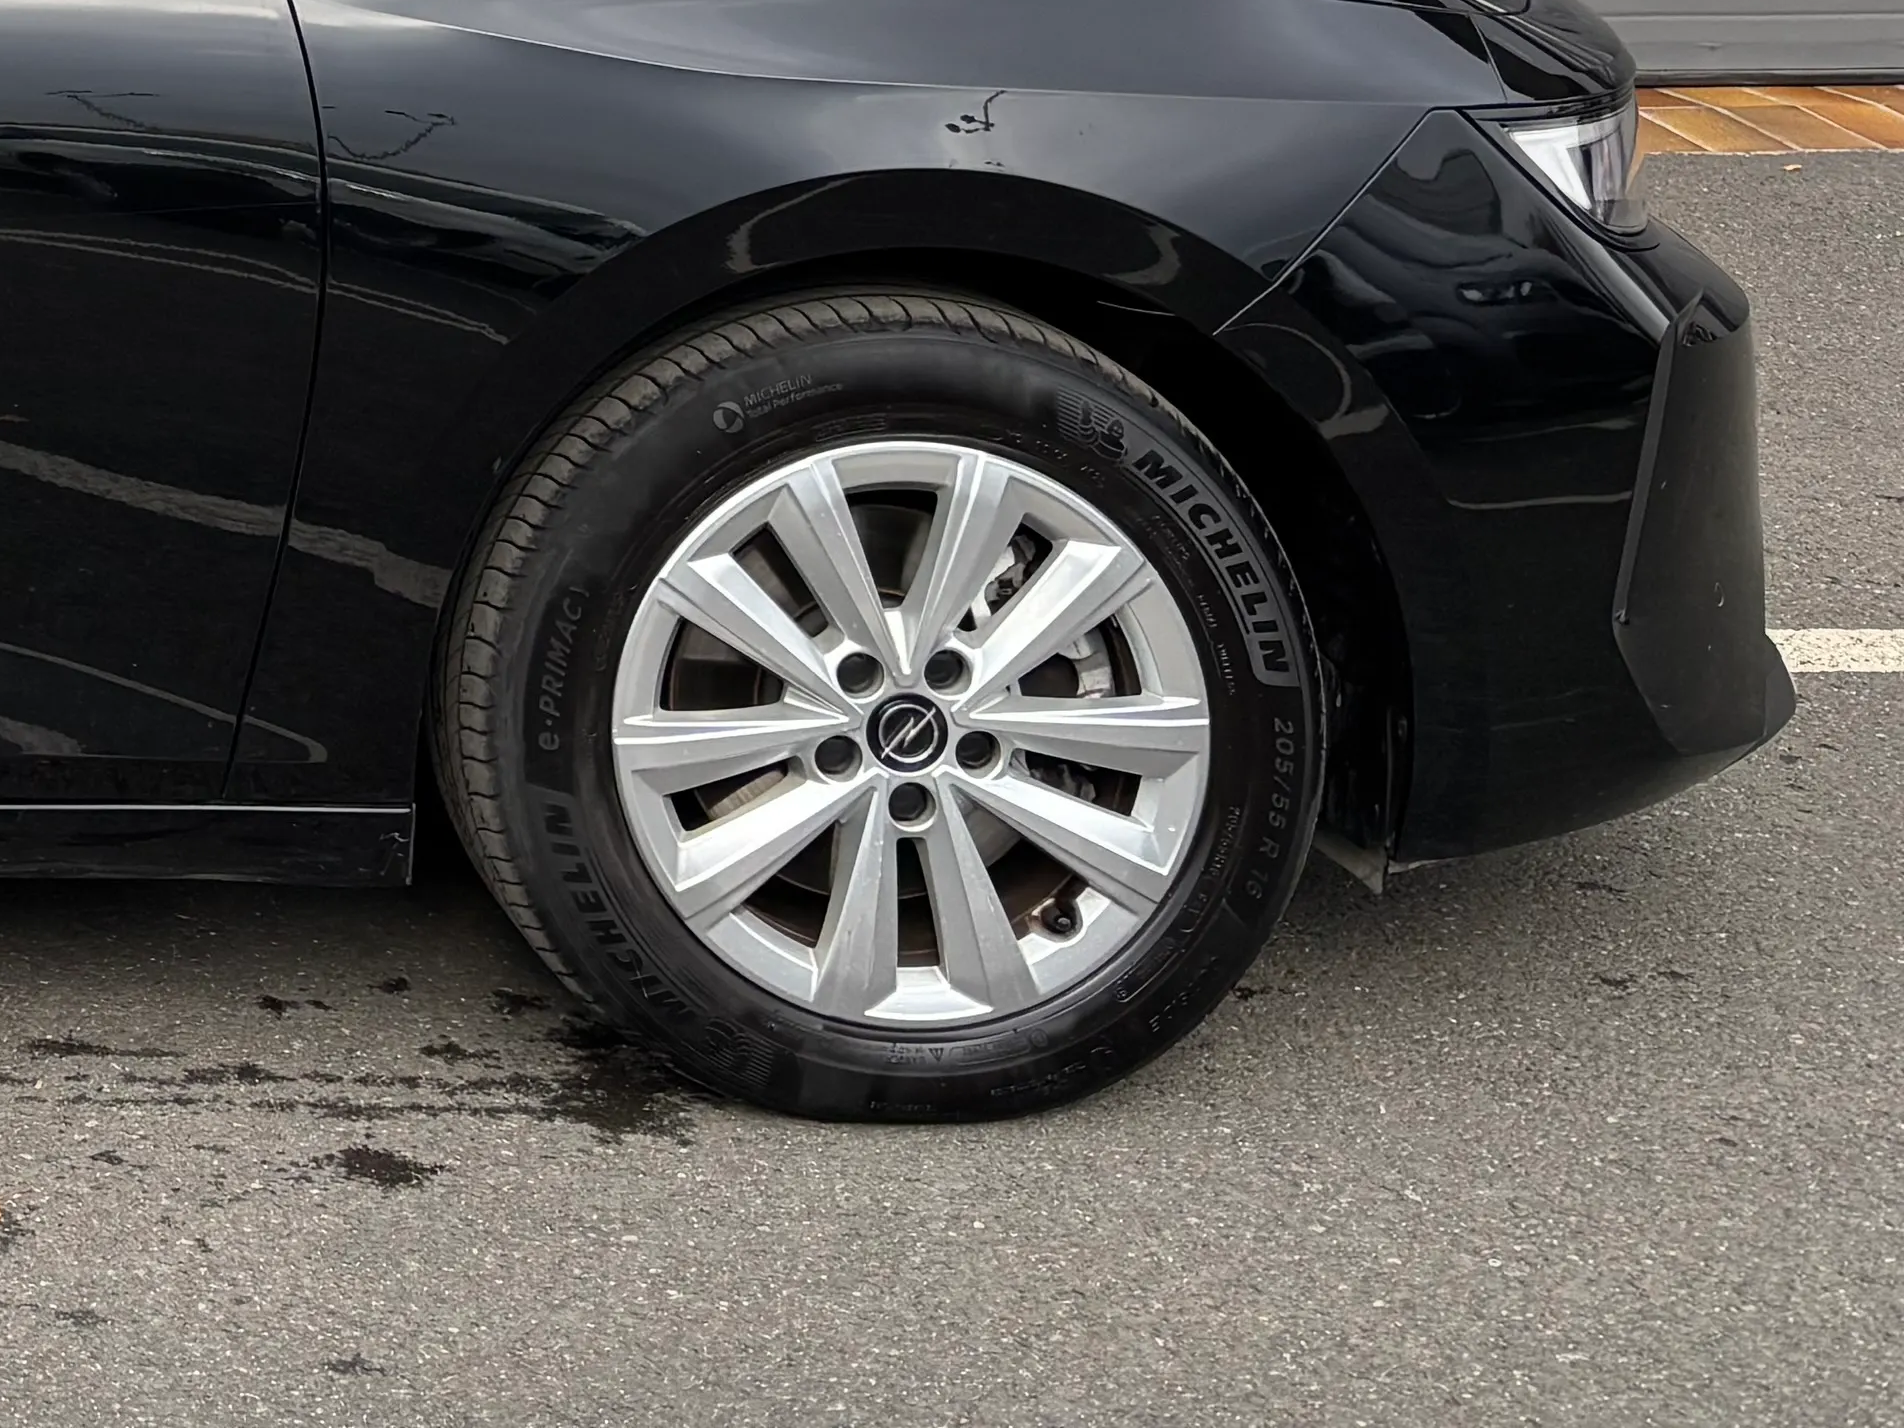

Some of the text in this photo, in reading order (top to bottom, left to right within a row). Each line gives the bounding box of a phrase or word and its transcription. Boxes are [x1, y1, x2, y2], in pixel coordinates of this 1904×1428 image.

[743, 374, 813, 406] MICHELIN
[1131, 448, 1290, 673] MICHELIN
[1268, 717, 1295, 829] 205/55
